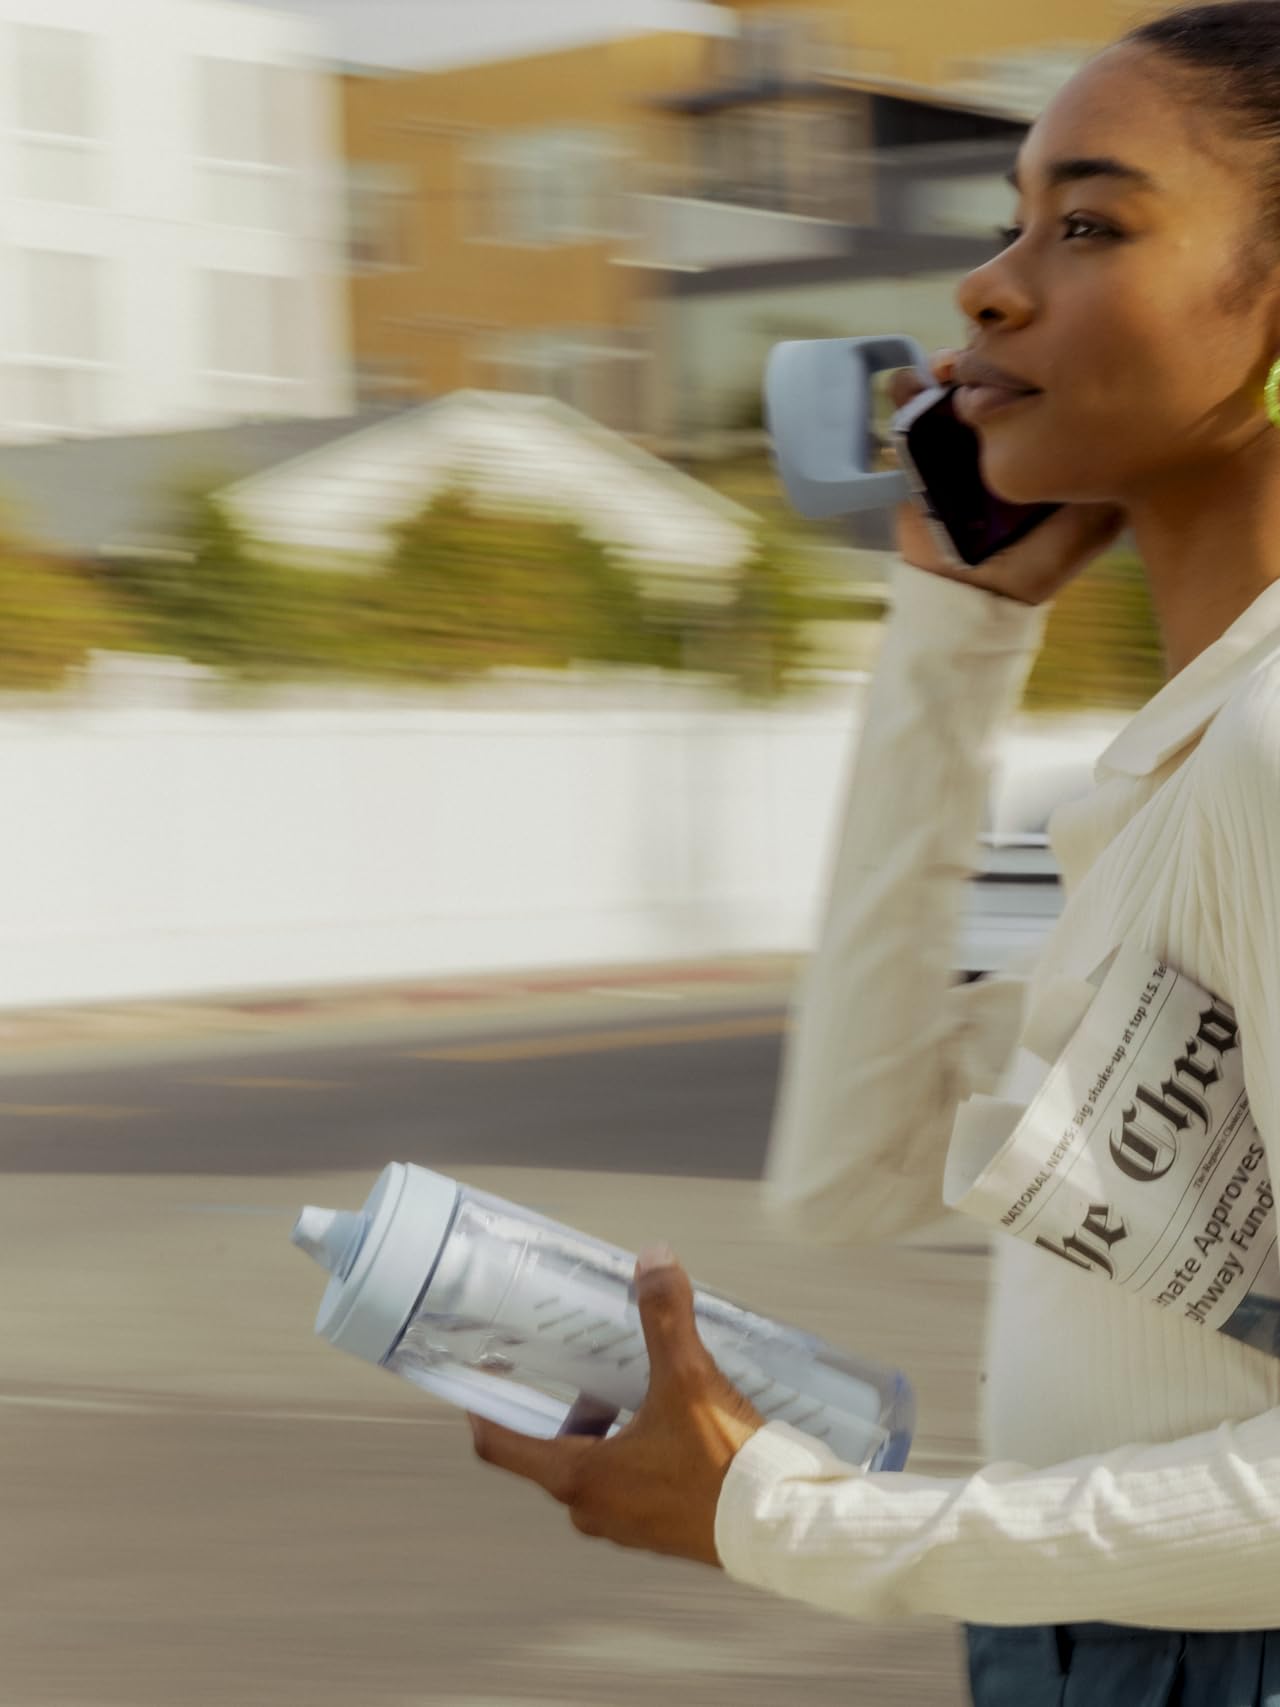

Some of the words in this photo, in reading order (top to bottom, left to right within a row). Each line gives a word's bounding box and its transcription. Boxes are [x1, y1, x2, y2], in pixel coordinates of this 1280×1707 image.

[1000, 1170, 1051, 1226] NATIONAL
[1046, 1127, 1079, 1168] NEWS:
[1073, 1105, 1094, 1126] Big
[1088, 1045, 1127, 1104] shake-up
[1122, 1028, 1135, 1044] at
[1129, 1006, 1148, 1028] top
[1140, 982, 1161, 1005] U.S.
[1036, 1205, 1128, 1280] he
[1109, 993, 1239, 1182] Chro
[1192, 1174, 1206, 1188] The
[1194, 1143, 1265, 1256] Approves
